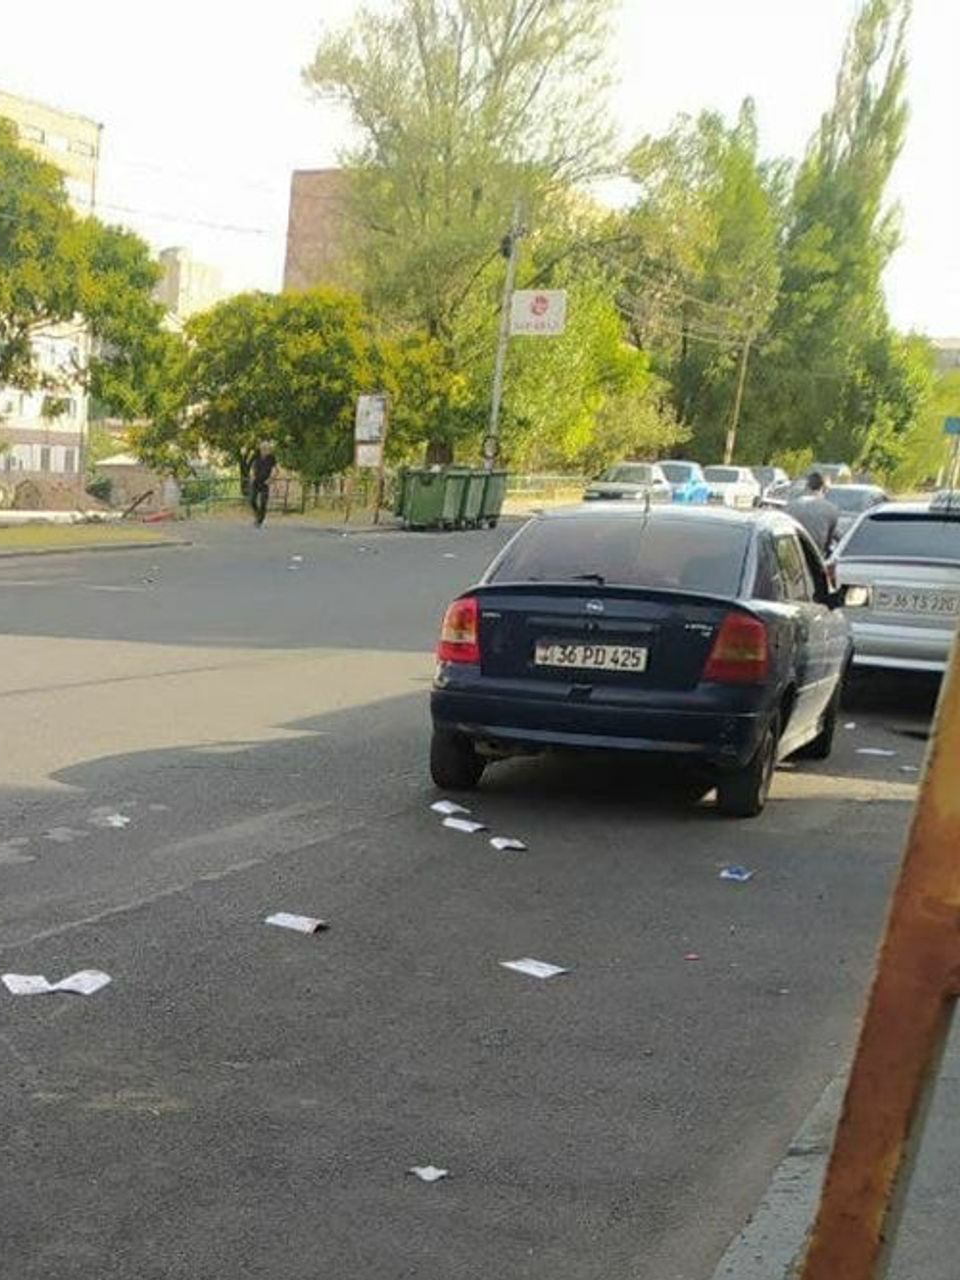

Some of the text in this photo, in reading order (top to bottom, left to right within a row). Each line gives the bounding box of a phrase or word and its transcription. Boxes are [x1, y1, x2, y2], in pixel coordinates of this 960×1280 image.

[557, 645, 641, 668] 36 PD 425
